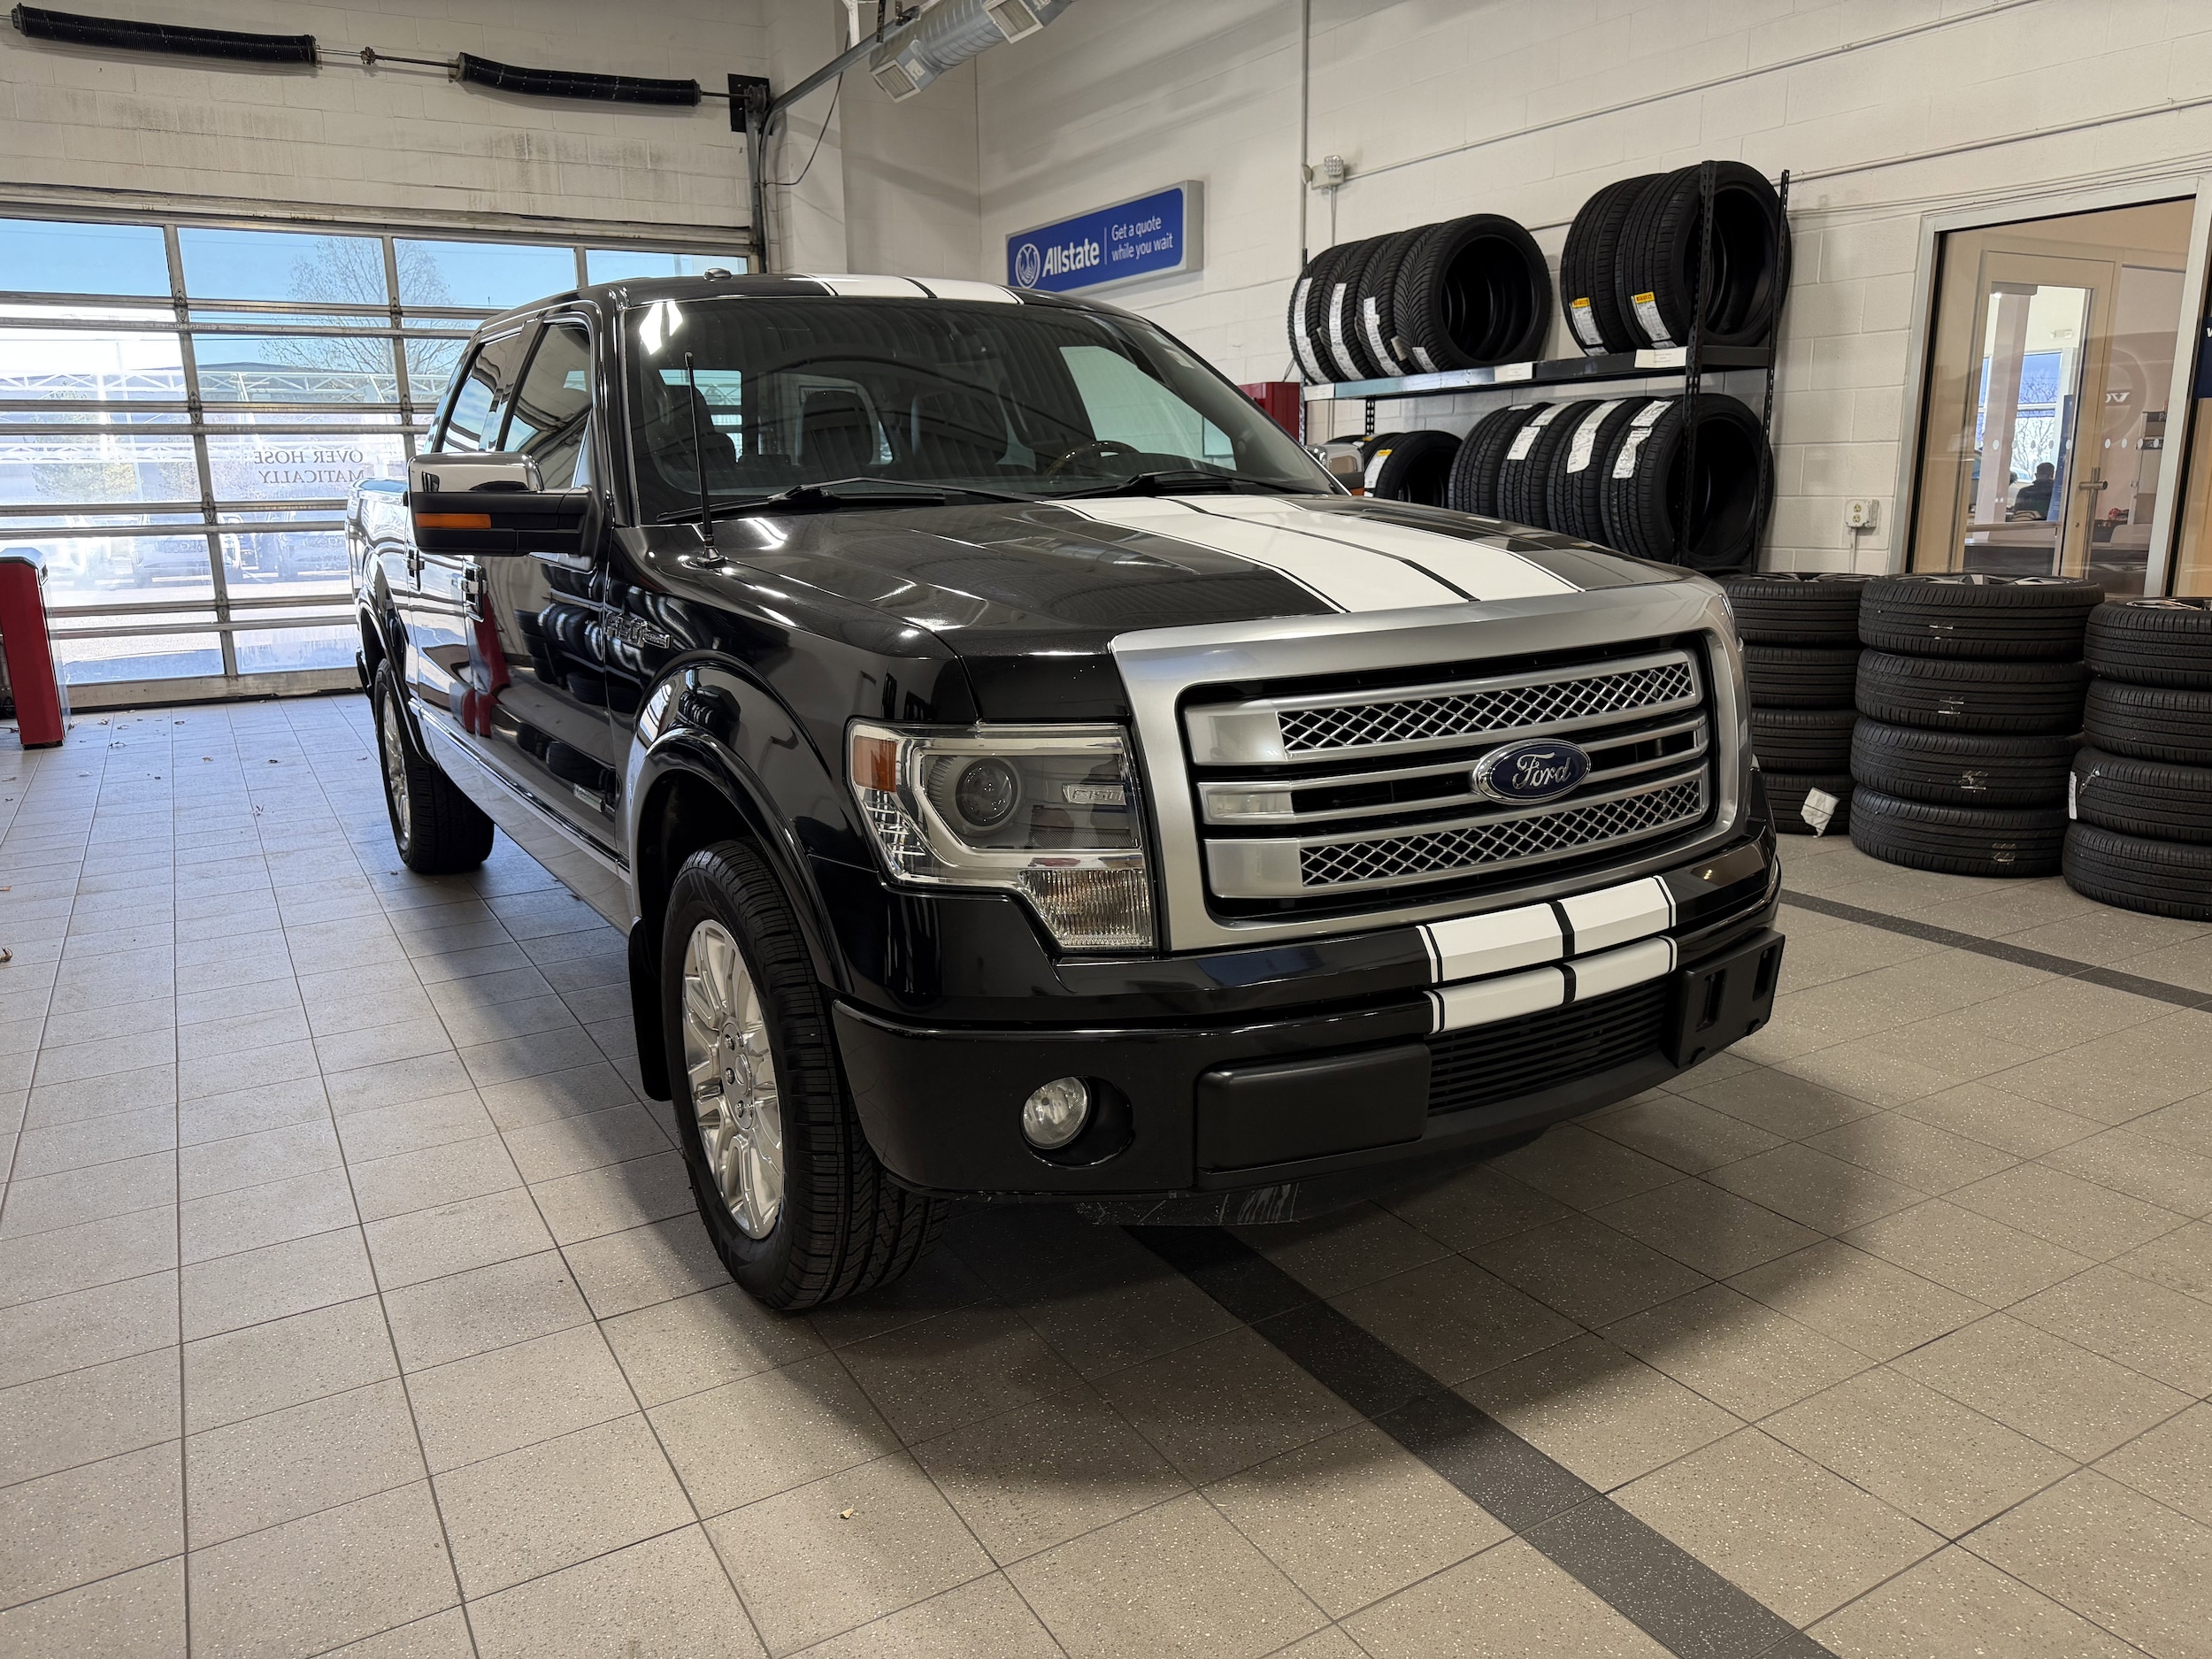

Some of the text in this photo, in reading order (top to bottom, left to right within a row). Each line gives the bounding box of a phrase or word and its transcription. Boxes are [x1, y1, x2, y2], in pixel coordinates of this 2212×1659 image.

[1111, 215, 1162, 242] Get a quote
[1042, 238, 1100, 277] Allstate
[1111, 234, 1173, 262] while you wait
[1512, 752, 1571, 790] Ford
